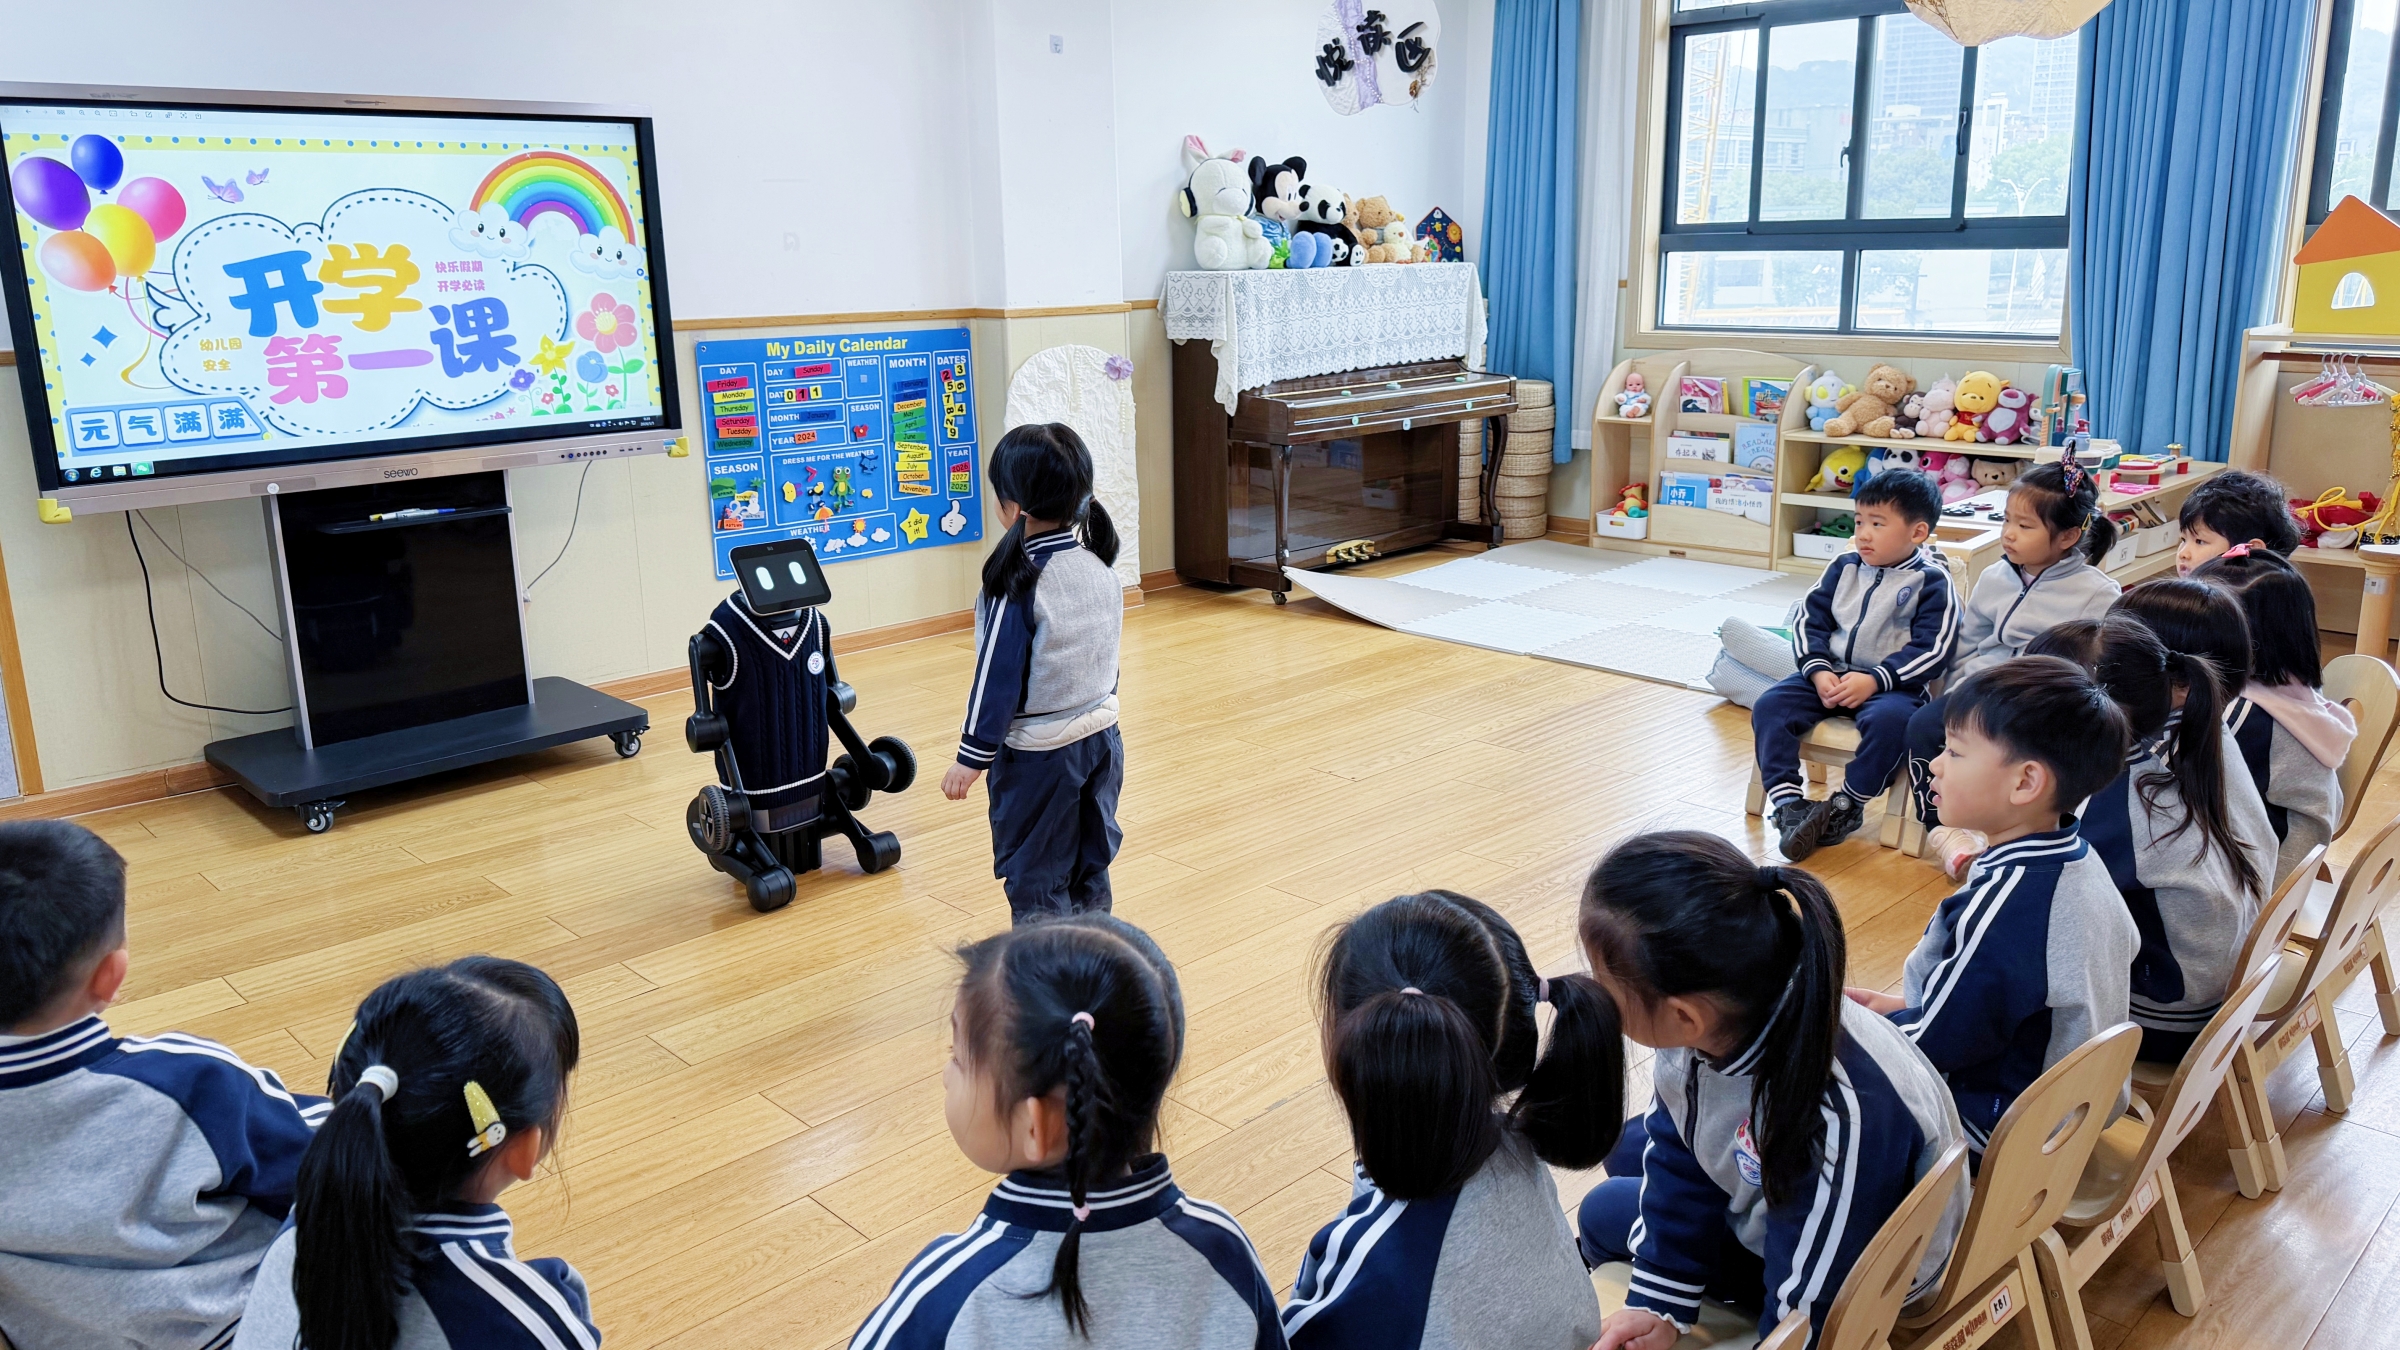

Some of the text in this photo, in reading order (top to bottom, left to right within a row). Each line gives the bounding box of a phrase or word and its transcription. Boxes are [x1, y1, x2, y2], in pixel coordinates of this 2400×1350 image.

[435, 260, 483, 273] 快乐假期
[222, 243, 423, 337] 开学
[437, 279, 486, 292] 开学必读
[199, 337, 243, 352] 幼儿园
[766, 336, 908, 359] My Daily Calendar
[263, 297, 521, 405] 第一课
[203, 358, 231, 372] 安全
[846, 358, 878, 367] WEATHER
[889, 357, 927, 369] MONTH
[937, 355, 967, 366] DATES
[720, 366, 738, 375] DAY
[767, 365, 824, 377] DAY Sunday
[942, 364, 964, 380] 2 3
[717, 379, 738, 388] Friday
[947, 381, 954, 391] 5
[722, 390, 747, 400] Monday
[769, 392, 784, 400] DAT
[944, 394, 951, 404] 7
[720, 404, 749, 413] Thursday
[850, 403, 880, 412] SEASON
[897, 401, 923, 411] December
[946, 404, 964, 415] 8 4
[770, 411, 830, 422] MONTH January
[903, 410, 915, 419] May
[80, 407, 246, 442] 元气满满
[721, 417, 750, 426] Saturday
[904, 420, 917, 429] April
[726, 428, 752, 436] Tuesday
[949, 427, 957, 437] 9
[717, 439, 753, 448] Wednesday
[772, 432, 816, 445] YEAR 2024
[897, 442, 927, 451] September
[1747, 446, 1776, 456] TREASU
[782, 456, 805, 465] DRESS
[831, 452, 845, 460] THE
[845, 449, 875, 458] WEATHER
[906, 452, 924, 460] August
[947, 449, 969, 458] YEAR
[713, 462, 759, 475] SEASON
[906, 463, 918, 471] July
[952, 463, 969, 472] 2026
[383, 467, 419, 479] seewo
[902, 472, 924, 480] October
[902, 484, 928, 494] November
[951, 483, 968, 491] 2025
[913, 517, 923, 526] did
[790, 525, 830, 537] WEATHER
